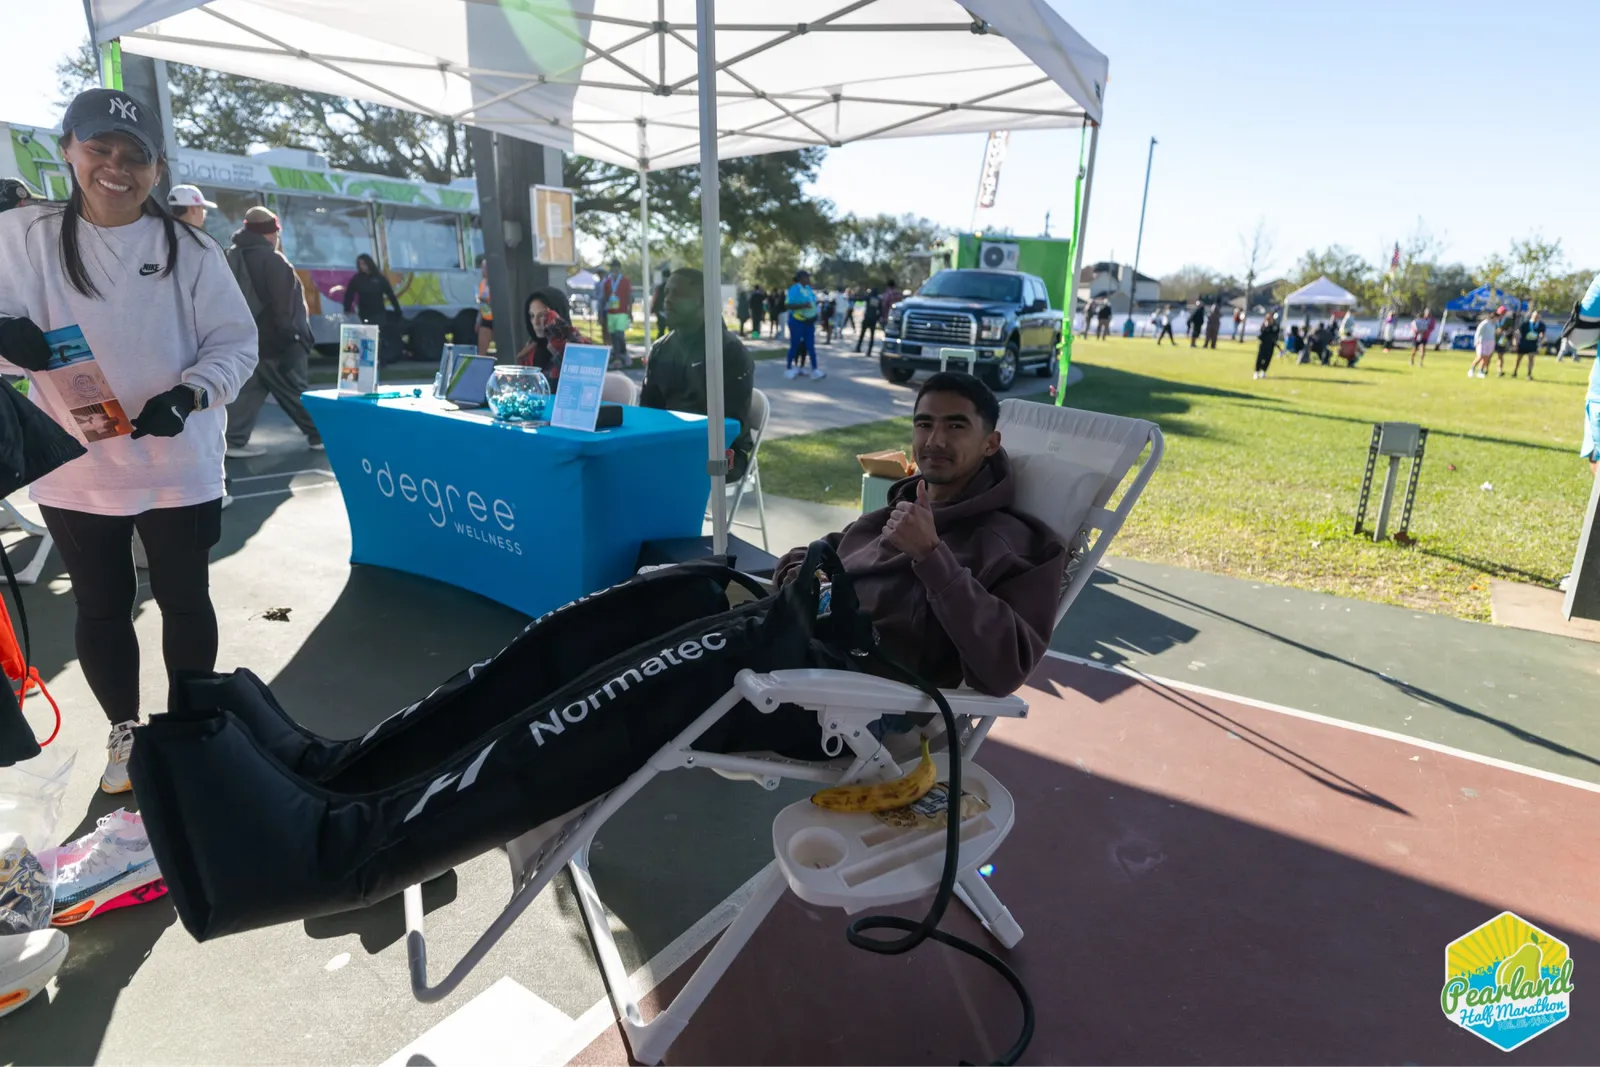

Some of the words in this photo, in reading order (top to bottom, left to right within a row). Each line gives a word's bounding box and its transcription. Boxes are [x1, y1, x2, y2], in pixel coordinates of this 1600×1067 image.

[177, 159, 231, 183] alata
[454, 521, 523, 556] WELLNESS
[528, 631, 728, 748] Normatec
